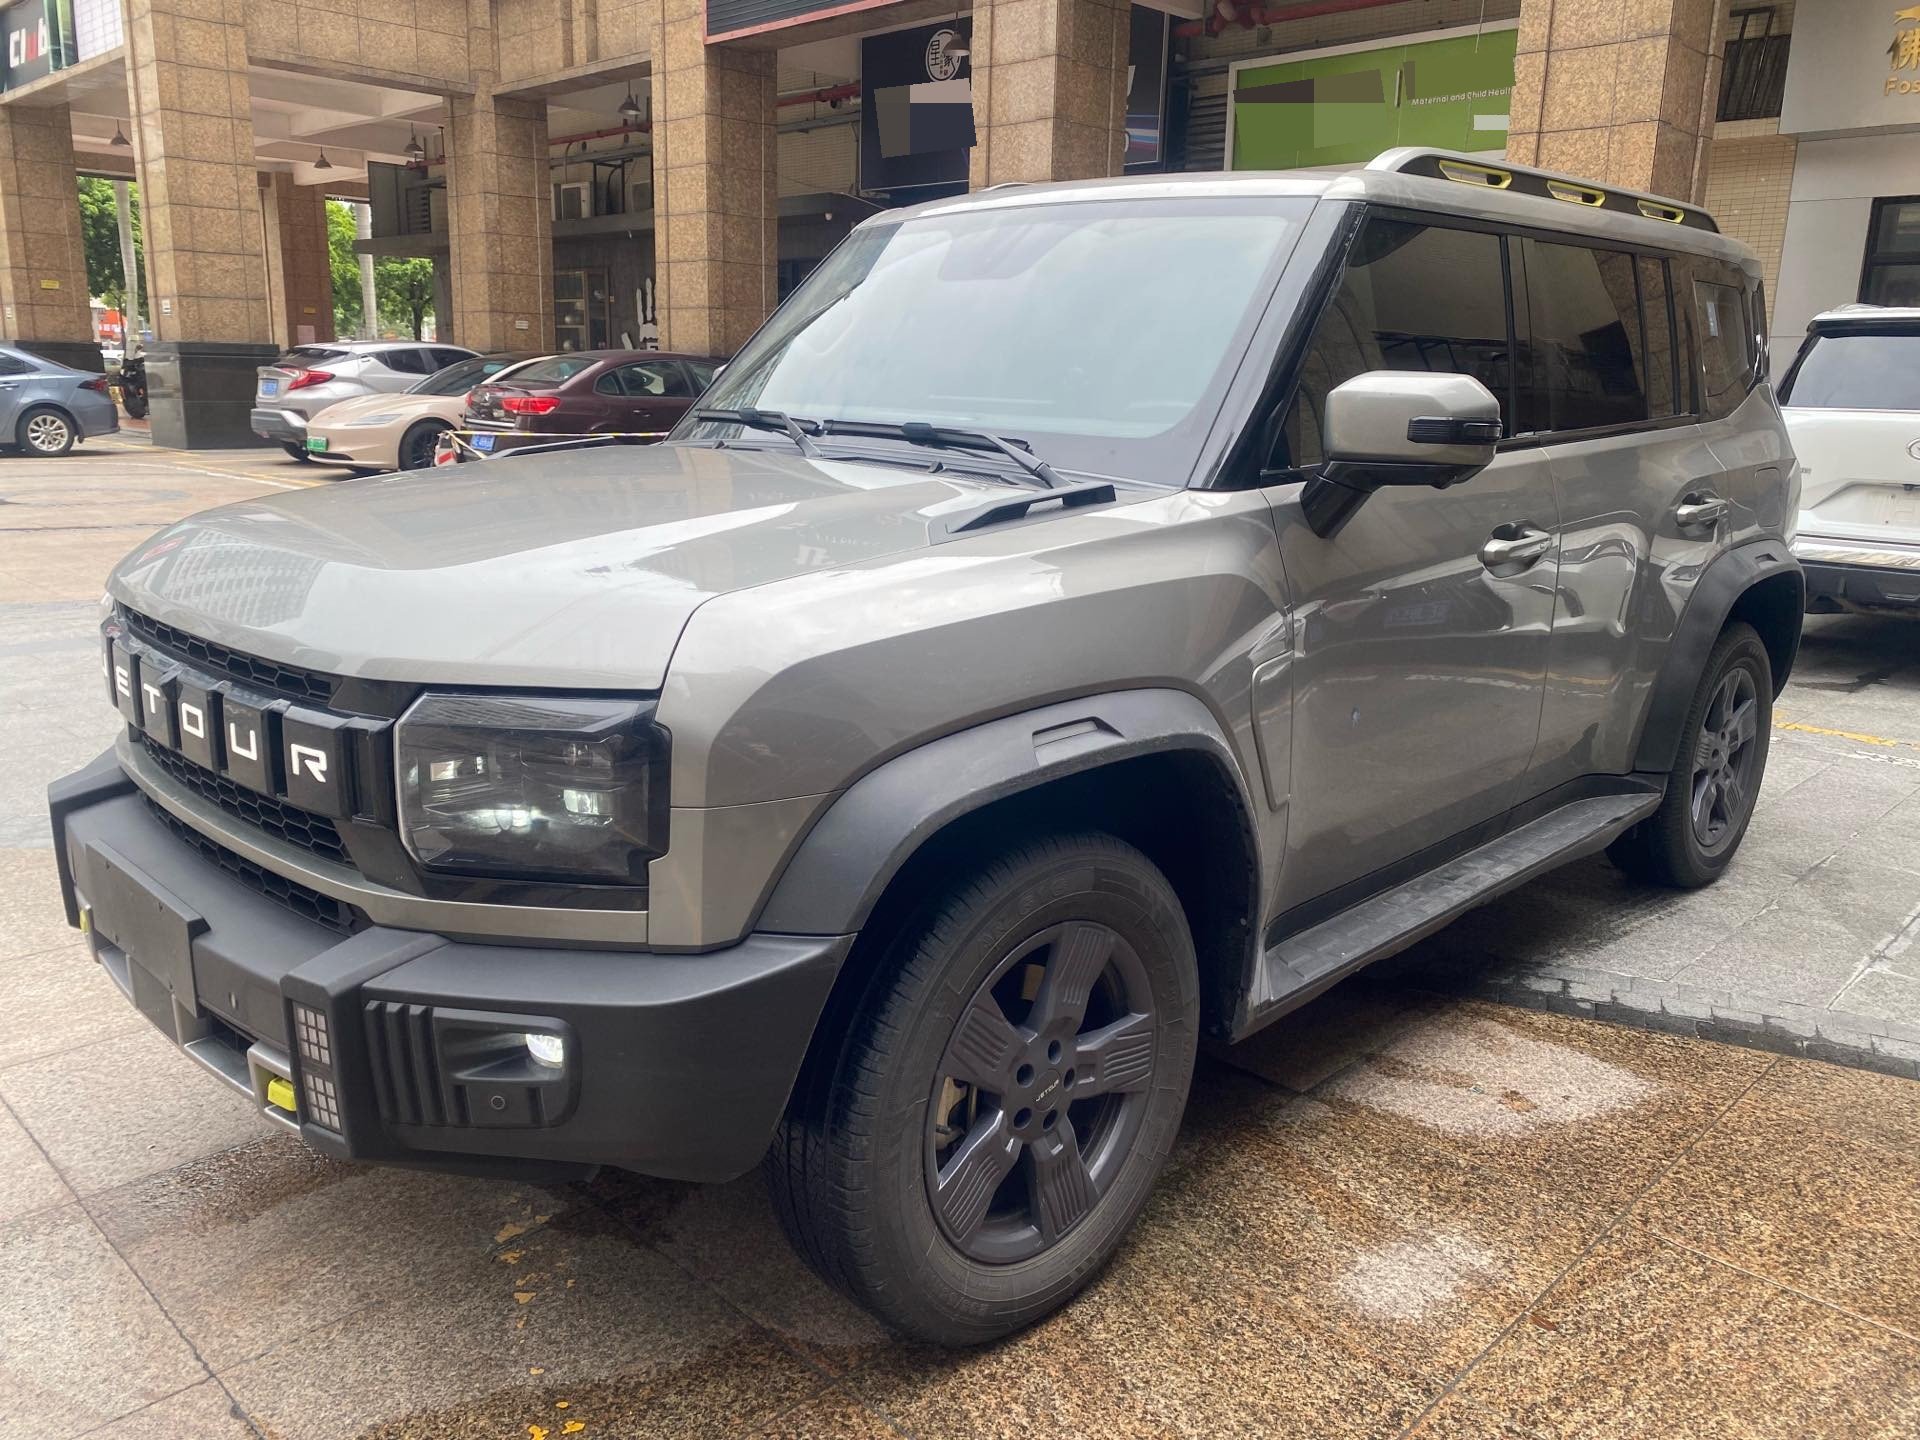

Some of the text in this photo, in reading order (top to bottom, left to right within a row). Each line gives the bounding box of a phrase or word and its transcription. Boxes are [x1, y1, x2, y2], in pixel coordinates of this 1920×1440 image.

[9, 18, 47, 68] Club
[1411, 86, 1513, 106] Maternal and Child Healt
[1035, 1080, 1059, 1102] JETOUR
